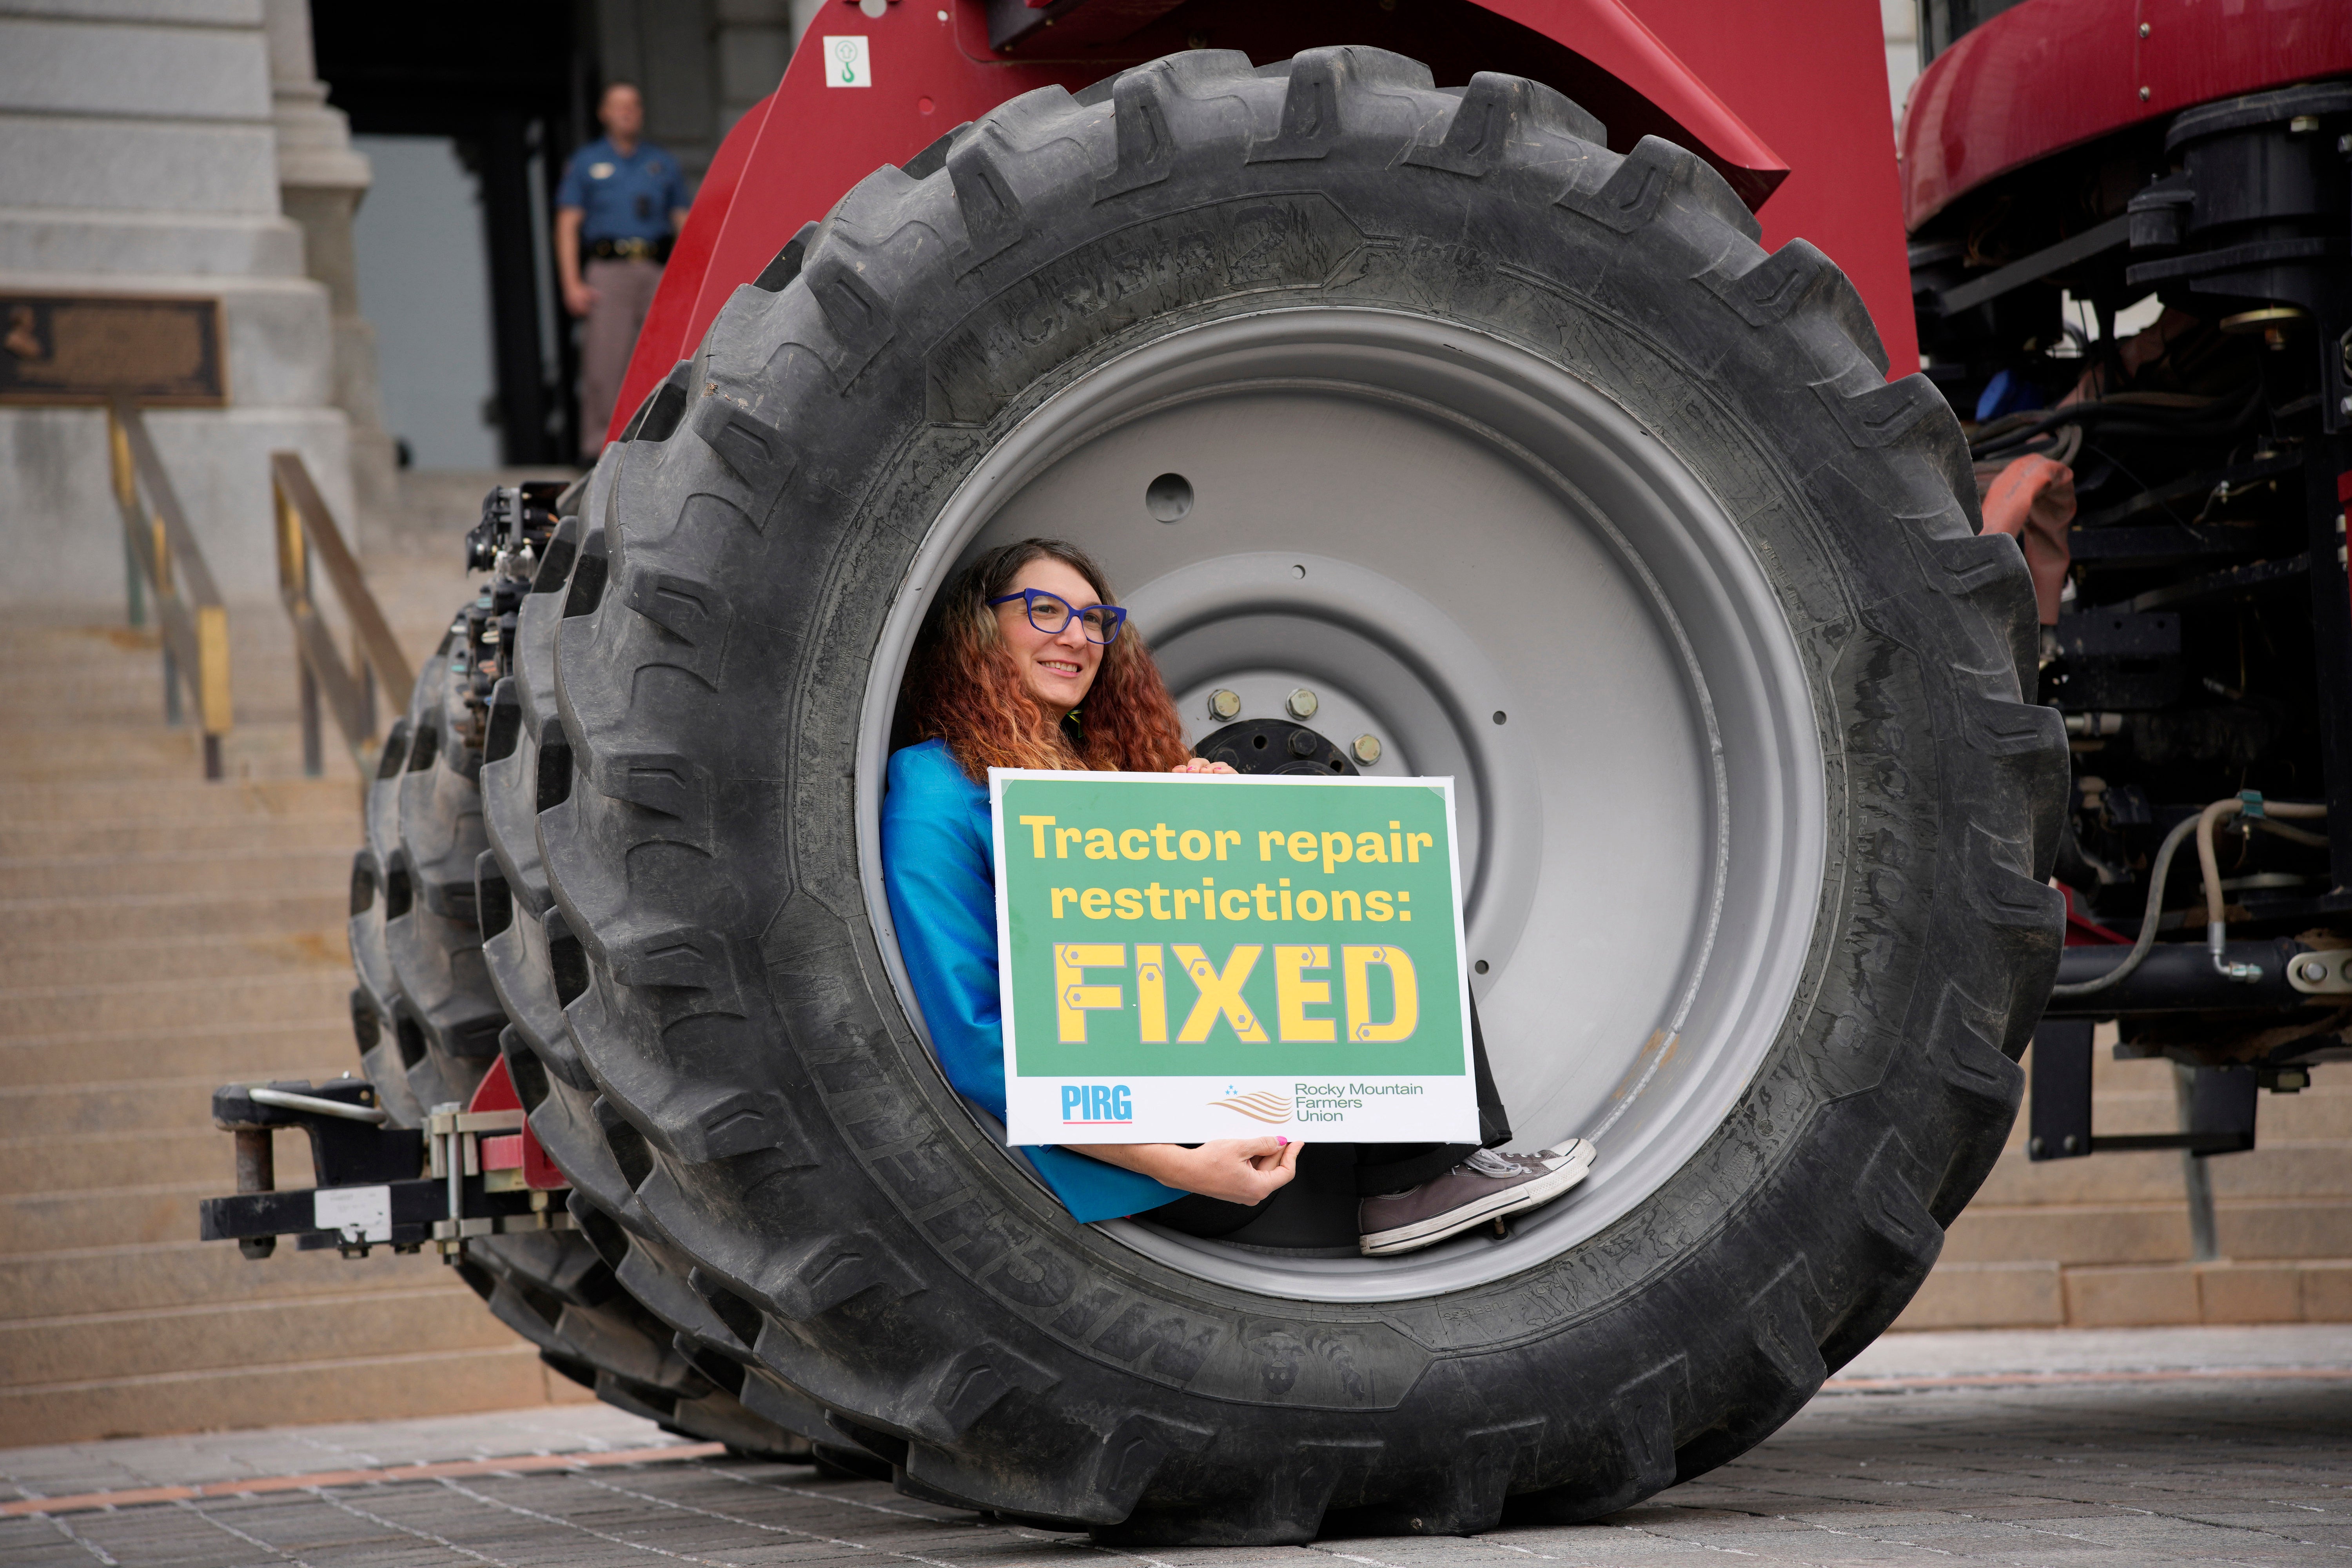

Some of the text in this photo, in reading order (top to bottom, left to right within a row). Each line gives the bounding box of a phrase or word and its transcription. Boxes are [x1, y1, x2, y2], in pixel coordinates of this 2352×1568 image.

[865, 575, 878, 597] SAFETY
[1760, 539, 1800, 606] MICHELIN
[853, 598, 869, 629] ADDITIONAL
[849, 629, 858, 642] FOR
[838, 641, 855, 682] INSTRUCTIONS
[828, 732, 836, 759] CONSULT
[845, 820, 853, 867] DISMOUNTING
[1020, 816, 1432, 874] Tractor repair
[1854, 815, 1868, 874] Replace
[1050, 877, 1412, 922] restrictions:
[1850, 877, 1863, 908] 18.4
[1053, 942, 1420, 1044] FIXED
[1062, 1085, 1132, 1120] PIRG
[1296, 1083, 1423, 1097] Rocky Mountain
[1296, 1097, 1362, 1108] Farmers
[1297, 1110, 1343, 1121] Union
[778, 972, 1224, 1382] MICHELIN
[1516, 1276, 1562, 1303] RADIAL
[1443, 1296, 1508, 1324] TUBELESS
